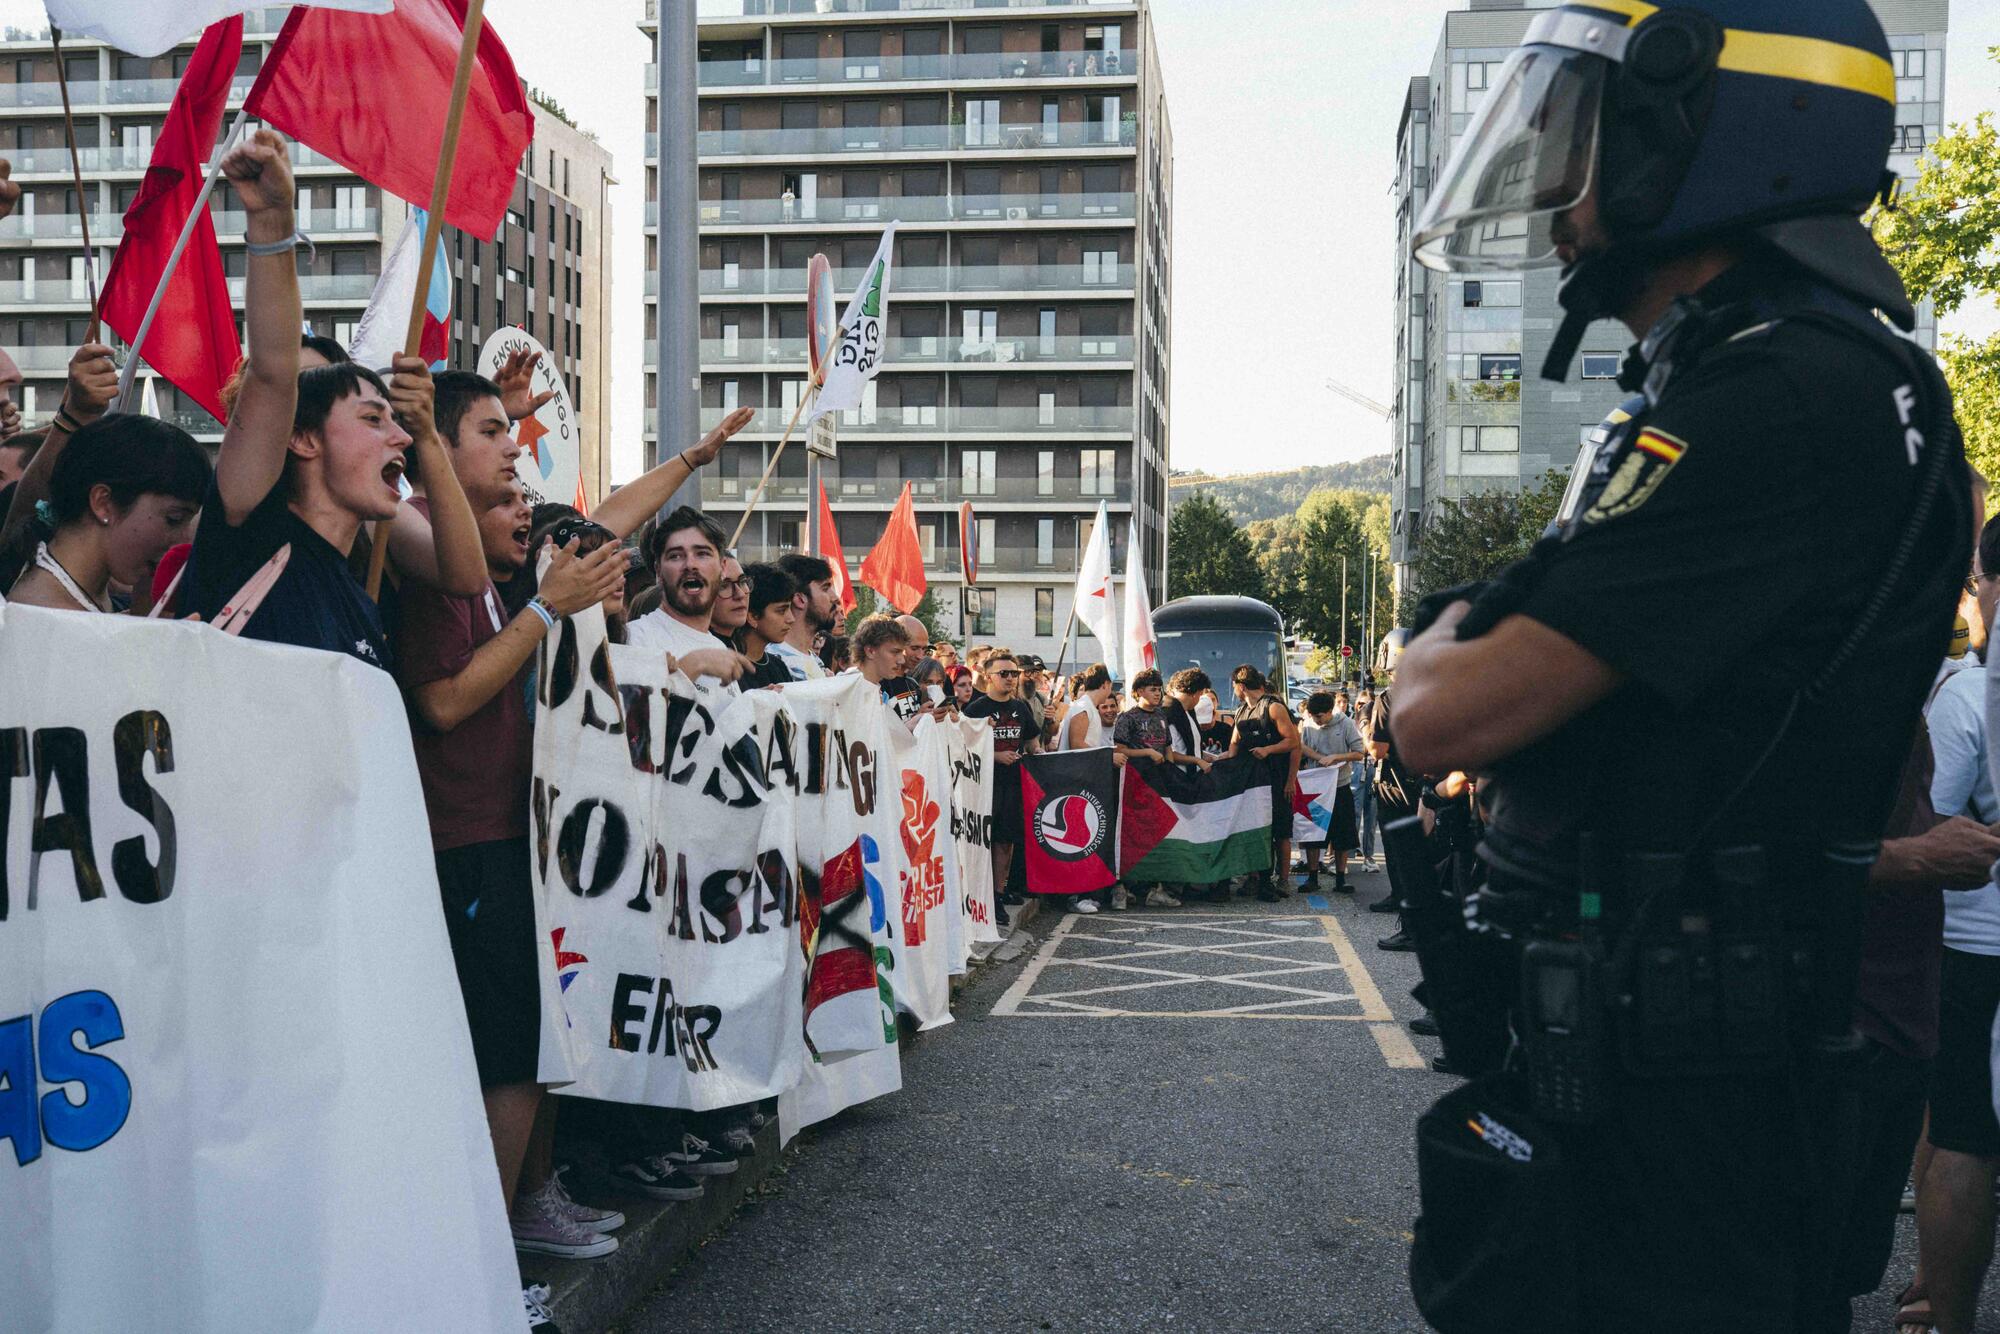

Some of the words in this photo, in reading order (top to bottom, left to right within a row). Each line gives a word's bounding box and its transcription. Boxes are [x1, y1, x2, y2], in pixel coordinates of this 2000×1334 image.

[536, 355, 570, 441] GALEGO
[1033, 807, 1045, 844] AKTION
[1080, 789, 1107, 857] ANTIFASCHISTISCHE
